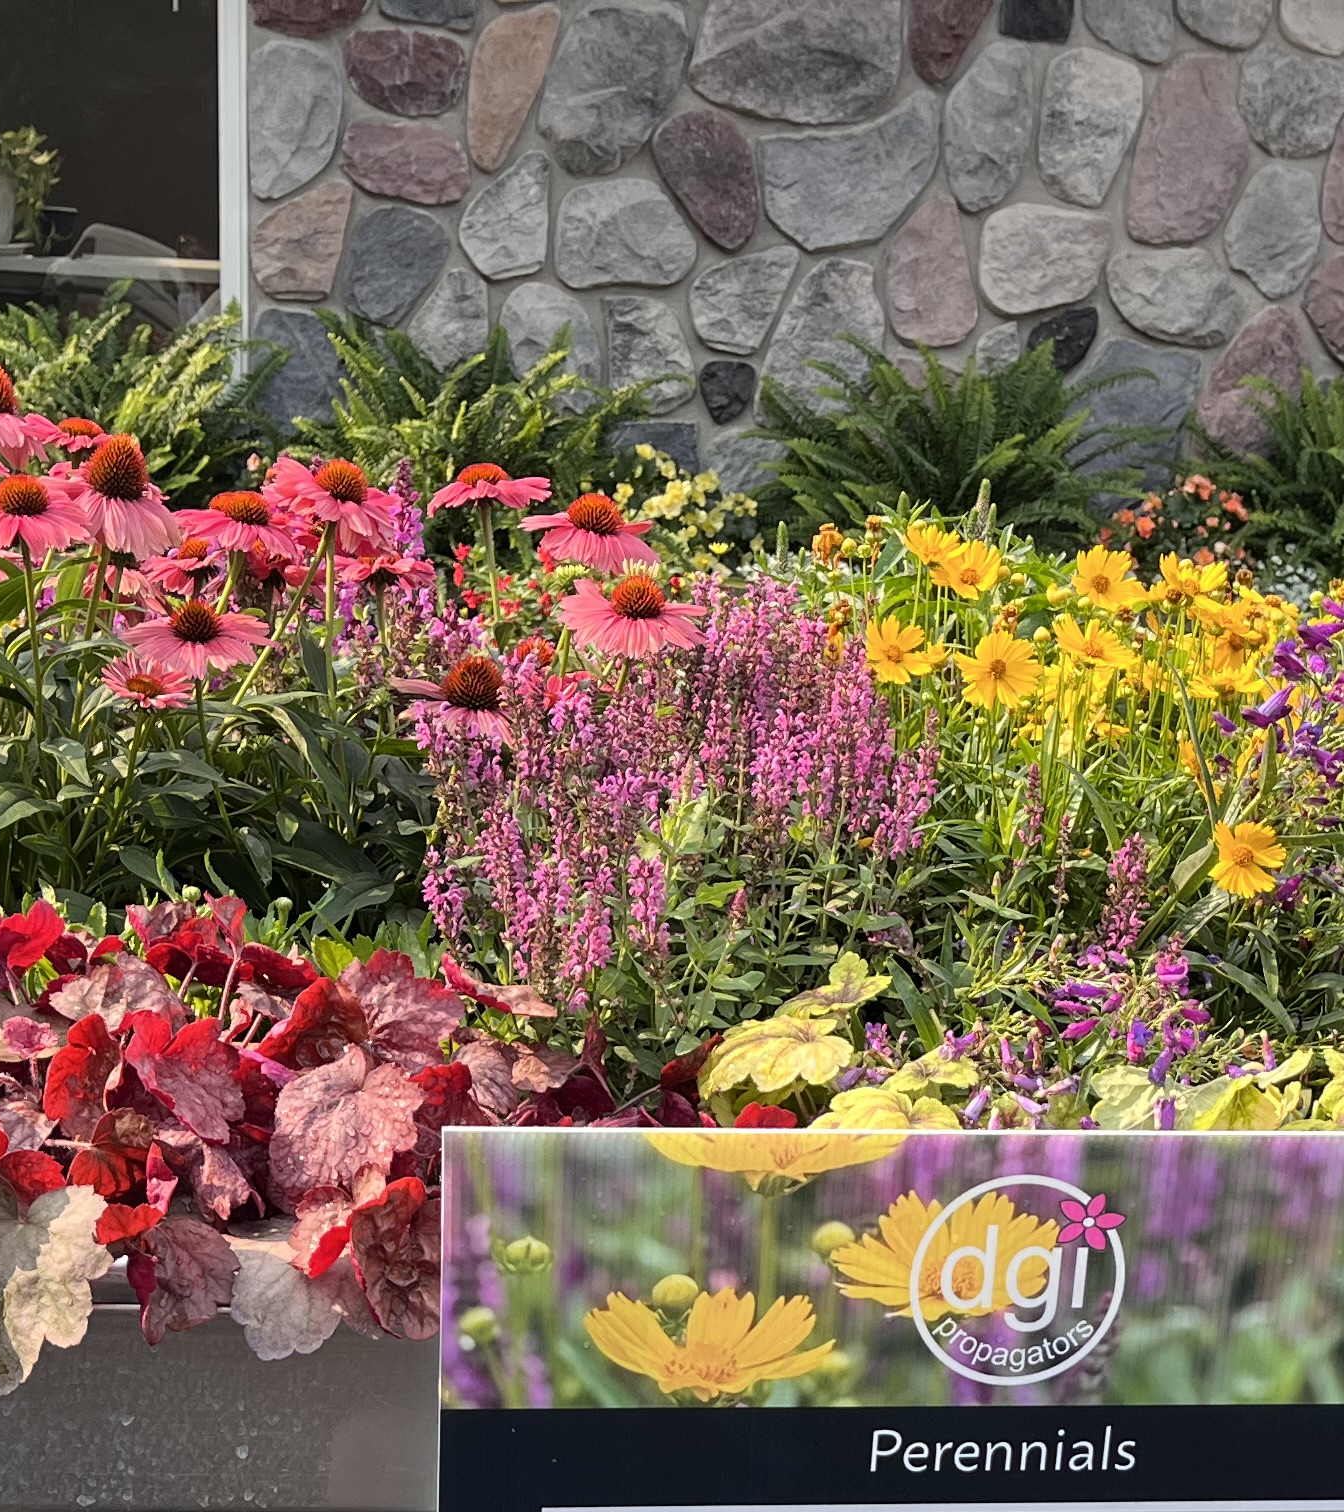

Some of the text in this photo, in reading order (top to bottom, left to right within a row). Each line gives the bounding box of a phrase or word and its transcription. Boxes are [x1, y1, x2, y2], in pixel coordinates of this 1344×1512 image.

[940, 1224, 1089, 1333] dgi
[931, 1316, 1095, 1374] propagators
[870, 1425, 1137, 1473] Perennials
